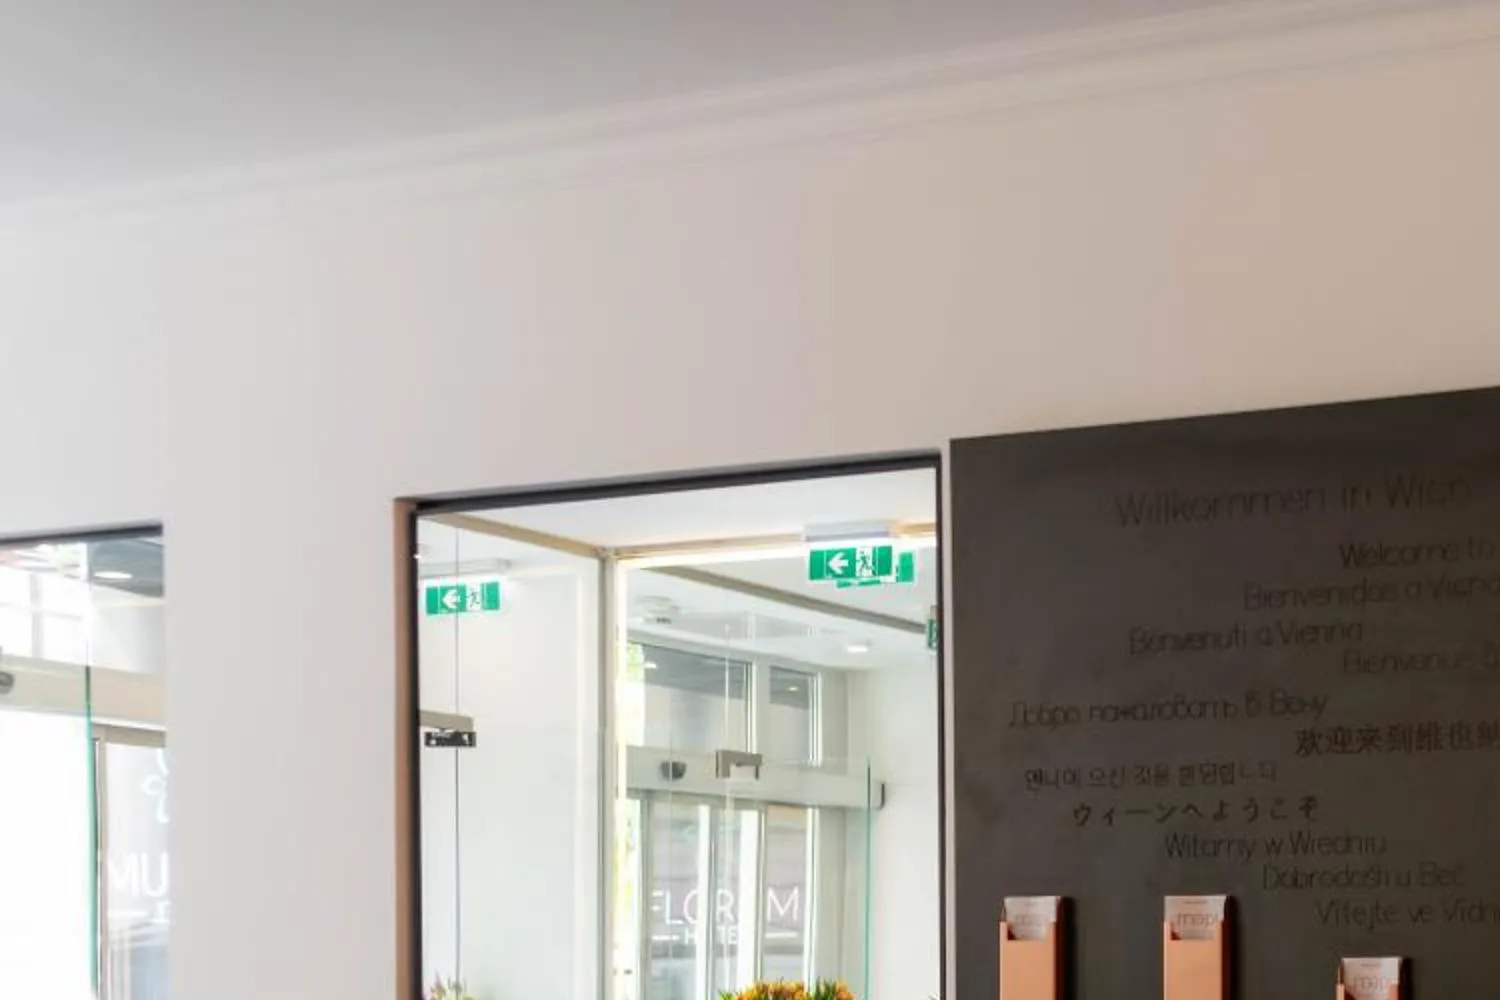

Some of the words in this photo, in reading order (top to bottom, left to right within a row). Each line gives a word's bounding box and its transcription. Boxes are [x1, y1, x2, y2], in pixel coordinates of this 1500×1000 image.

[1115, 485, 1326, 528] Willkommen
[1073, 796, 1318, 828] ウィーンへようこそ
[652, 886, 799, 924] FLORM
